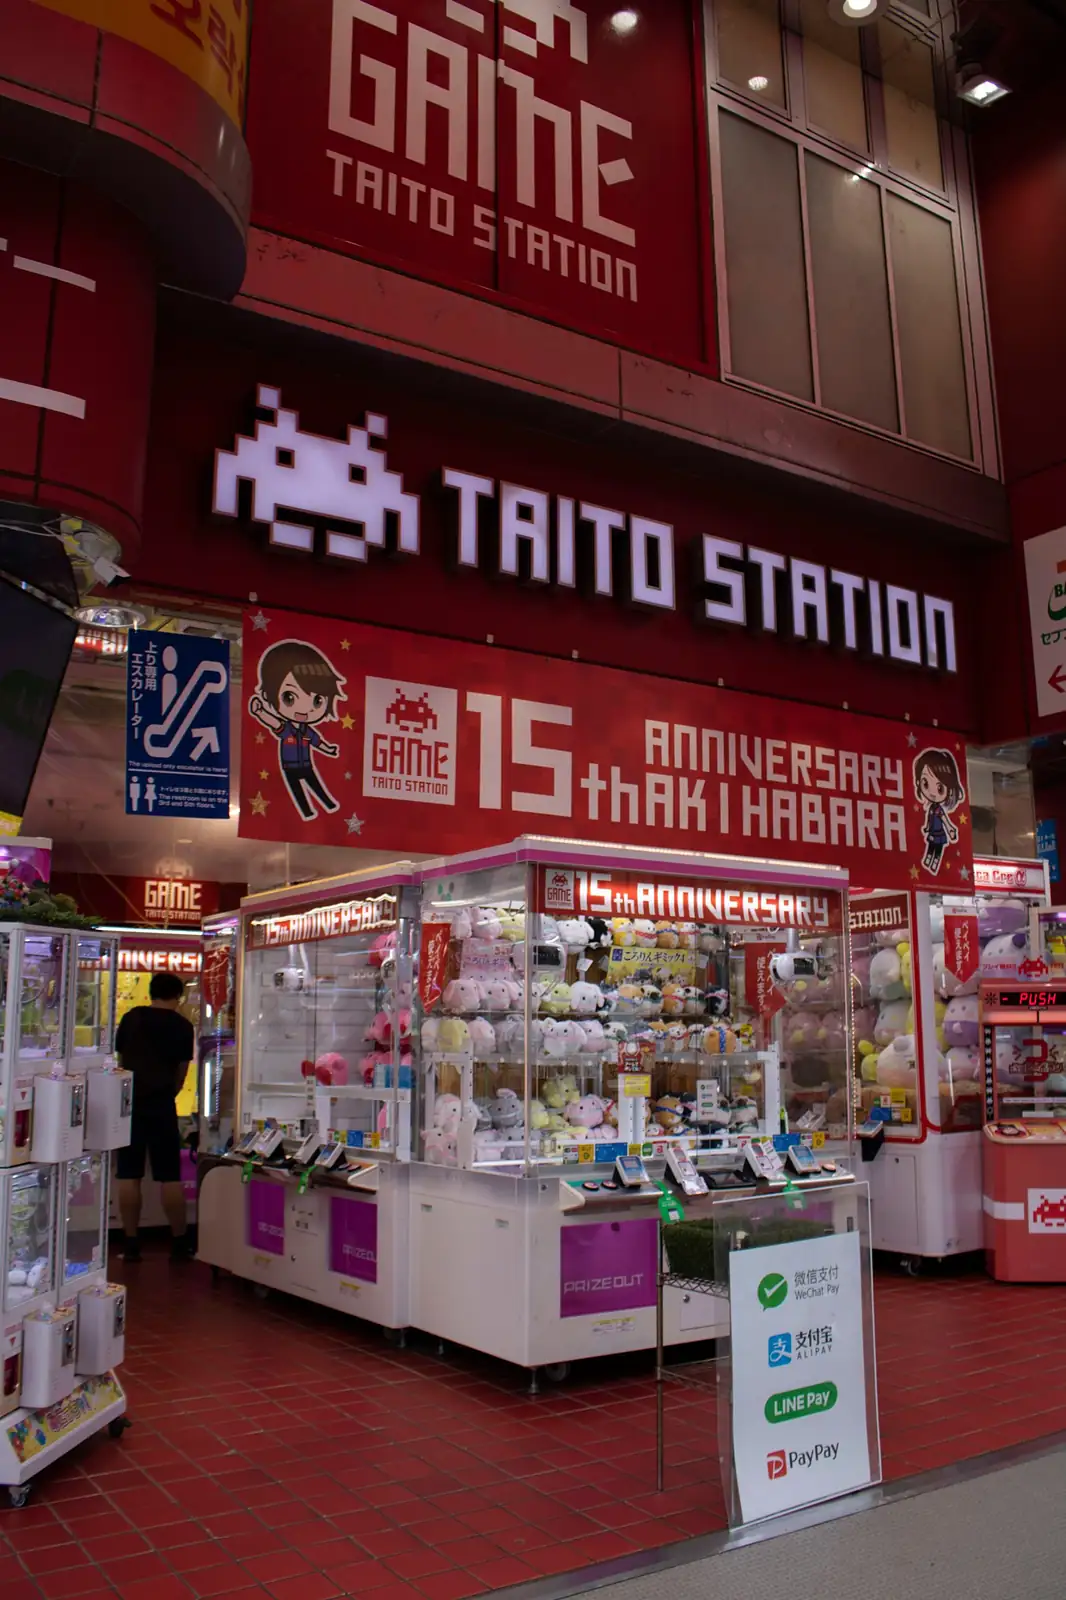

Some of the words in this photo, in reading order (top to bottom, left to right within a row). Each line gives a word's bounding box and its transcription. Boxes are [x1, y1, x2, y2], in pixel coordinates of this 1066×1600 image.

[327, 0, 636, 247] GAME
[326, 149, 455, 236] TAITO
[473, 205, 637, 302] STATION
[442, 466, 676, 611] TAITO
[702, 533, 957, 672] STATION
[144, 641, 158, 691] 上り専用
[130, 653, 144, 739] エスカレーター
[371, 732, 449, 780] GAME
[466, 691, 639, 824] 15th
[645, 719, 904, 799] ANNIVERSARY
[371, 776, 402, 791] TAITO
[405, 780, 448, 796] STATION
[645, 772, 908, 852] AKIHABARA
[144, 880, 202, 909] GAME
[547, 887, 572, 902] GAME
[575, 870, 635, 916] 15th
[636, 882, 829, 927] ANNIVERSARY
[144, 908, 166, 919] TAITO
[168, 909, 201, 920] STATION
[849, 906, 902, 929] STATION
[1019, 992, 1057, 1006] PUSH
[794, 1264, 839, 1285] 微信支付
[794, 1287, 824, 1301] WeChat
[826, 1284, 840, 1297] Pay
[795, 1325, 833, 1350] 支付宝
[796, 1344, 833, 1360] ALIPAY
[773, 1392, 805, 1417] LINE
[806, 1390, 831, 1409] Pay
[788, 1442, 840, 1470] PayPay
